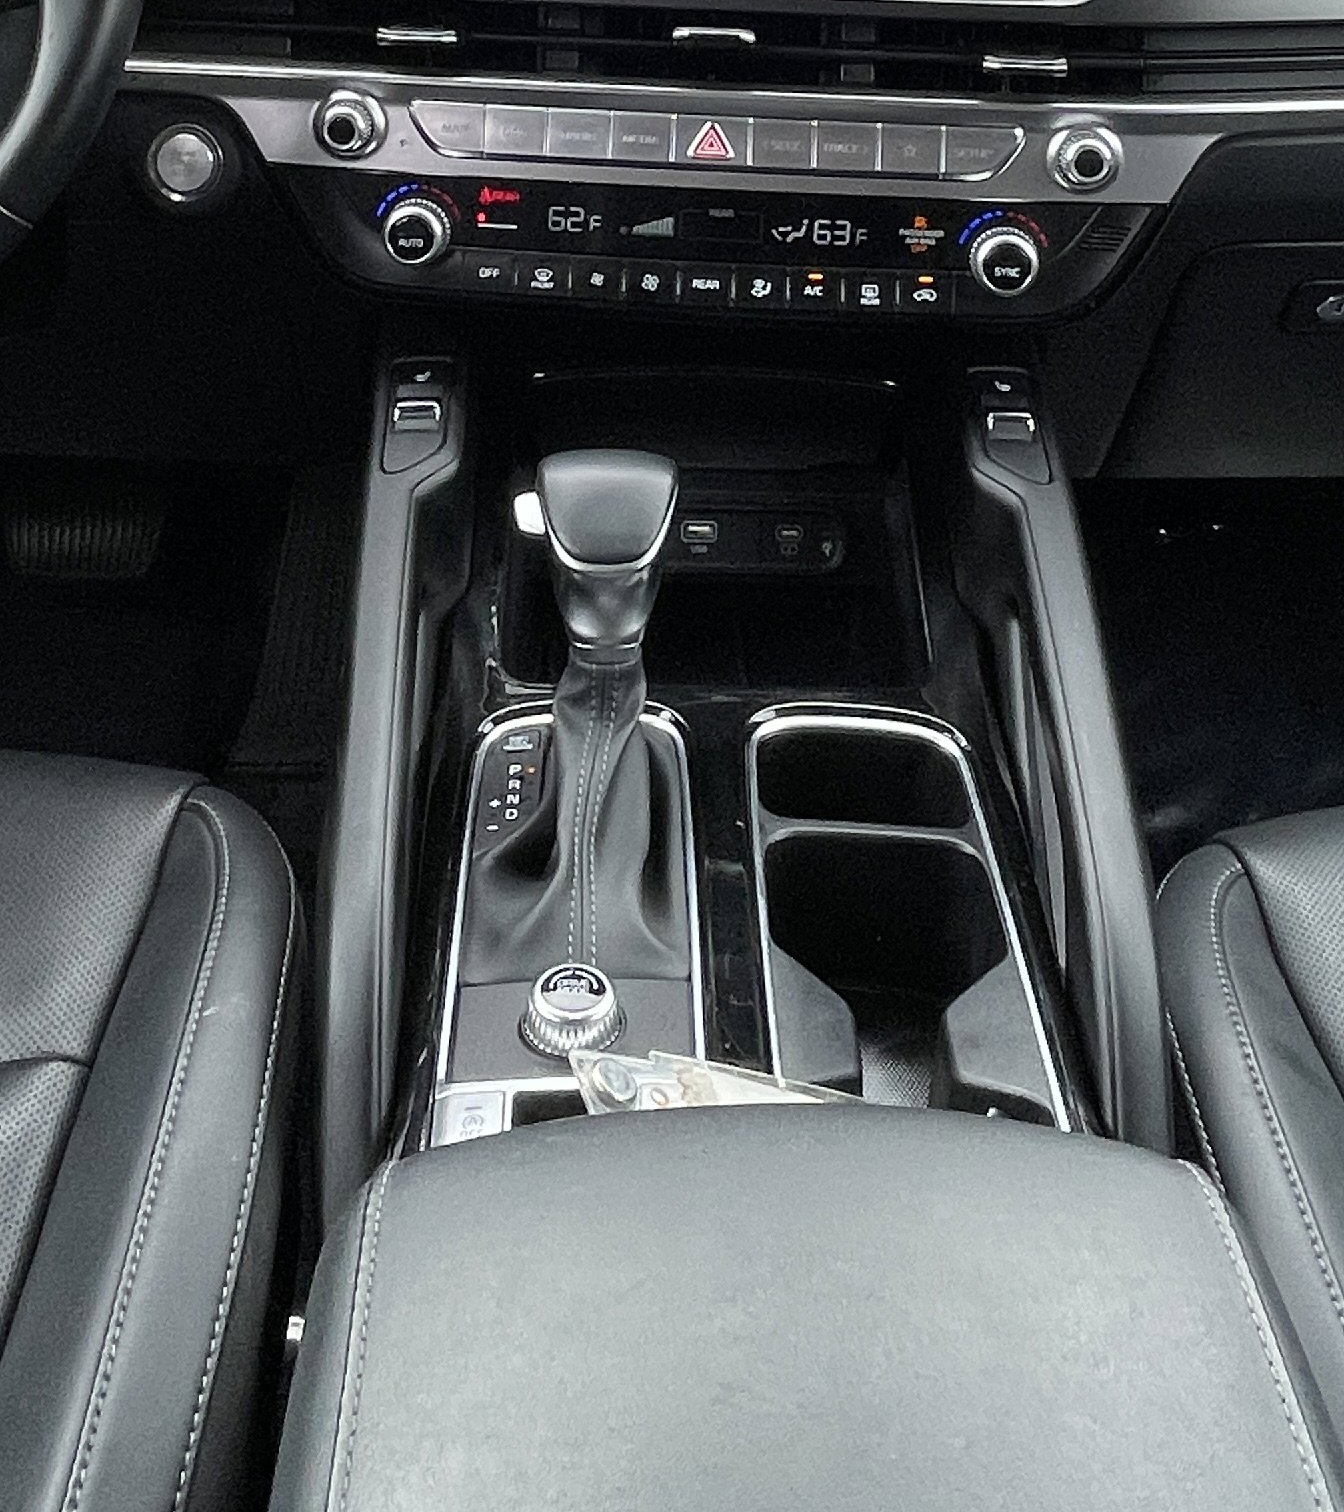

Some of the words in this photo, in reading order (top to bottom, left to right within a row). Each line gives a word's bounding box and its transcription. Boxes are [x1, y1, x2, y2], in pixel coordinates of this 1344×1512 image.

[397, 238, 424, 249] AUTO
[478, 266, 500, 278] OFF
[993, 266, 1022, 279] SYNC
[691, 278, 721, 290] REAR
[803, 285, 824, 296] A/C
[508, 764, 523, 776] P
[506, 794, 520, 805] N
[504, 808, 519, 820] D
